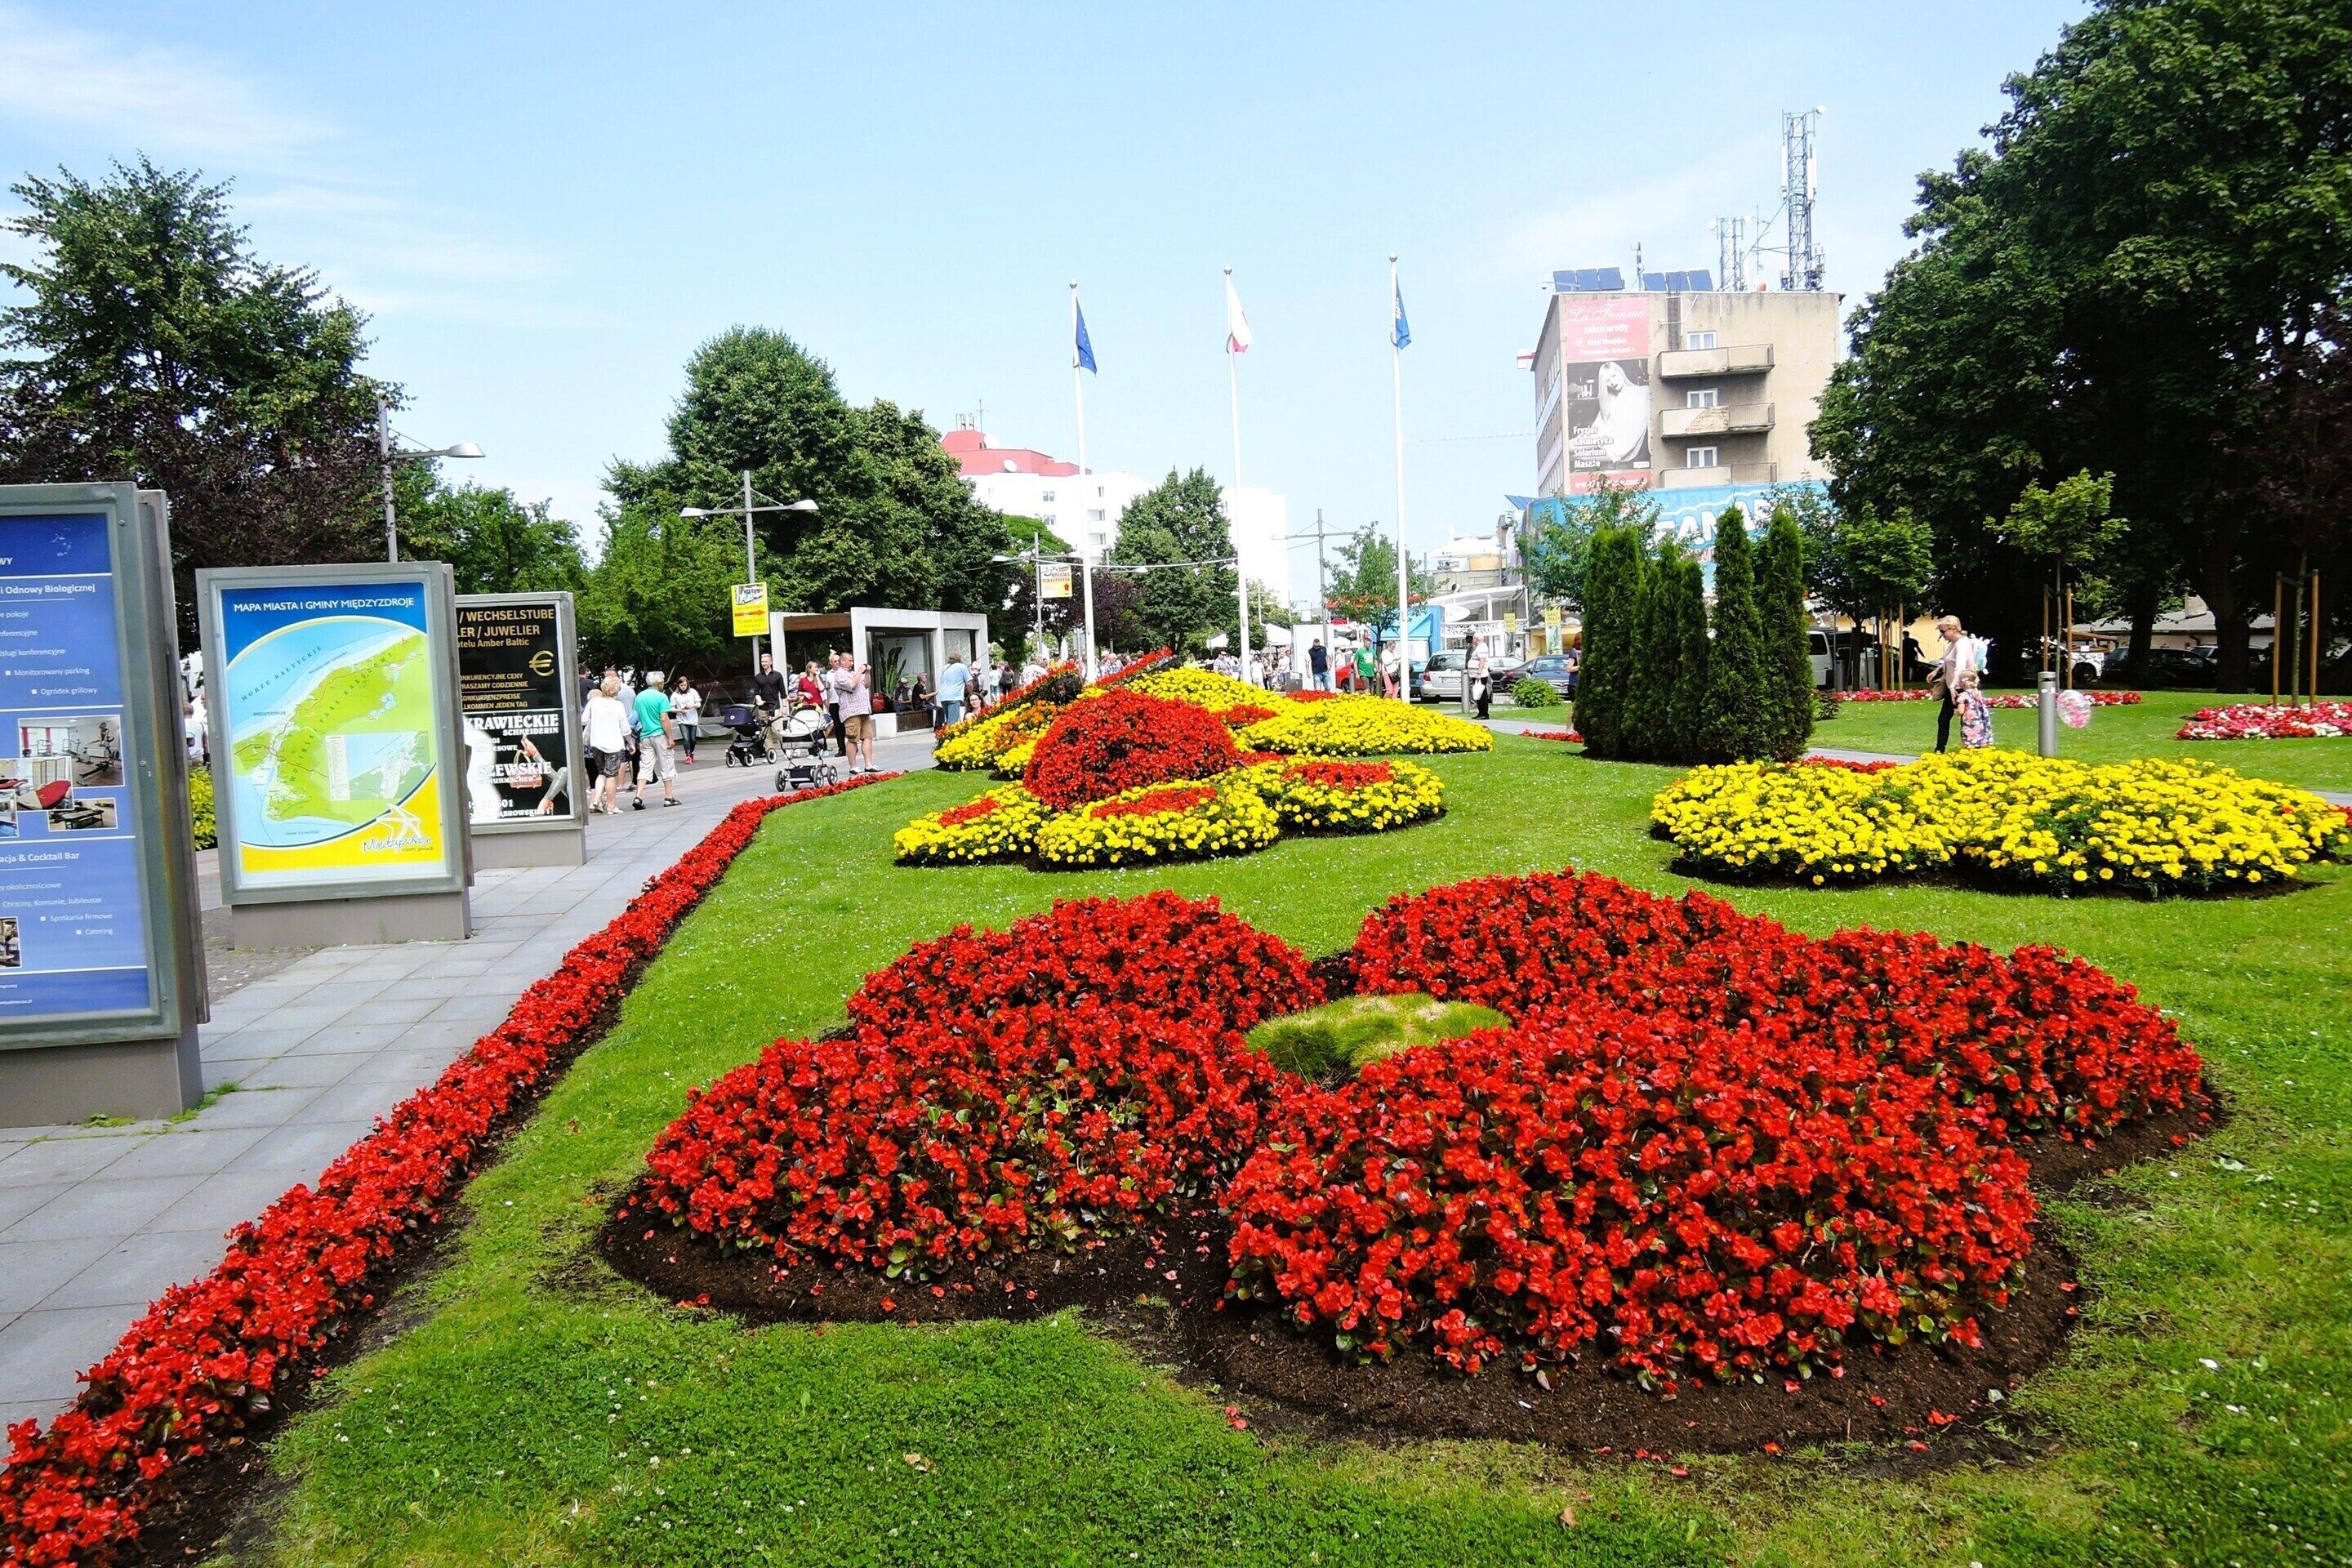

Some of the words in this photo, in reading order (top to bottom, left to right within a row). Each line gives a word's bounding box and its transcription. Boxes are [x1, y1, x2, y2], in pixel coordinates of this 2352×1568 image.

[1585, 325, 1605, 333] salon
[1606, 323, 1628, 333] urody
[1573, 425, 1598, 435] Fryzjer
[1574, 436, 1614, 446] Kosmetyka
[1574, 448, 1606, 457] Solarium
[1574, 459, 1601, 468] Masaże
[6, 586, 42, 595] Odnowy
[45, 583, 95, 593] Biologicznej
[234, 604, 261, 612] MAPA
[263, 602, 299, 610] MIASTA
[300, 601, 303, 609] I
[305, 600, 339, 609] GMINY
[341, 597, 414, 609] MIĘDZYZDROJE
[466, 608, 555, 621] WECHSELSTUBE
[457, 627, 475, 637] ER
[483, 625, 541, 636] JUWELIER
[477, 639, 505, 648] Amber
[506, 637, 529, 646] Baltic
[65, 667, 90, 675] parking
[41, 688, 69, 696] Ogródek
[241, 680, 270, 702] MORZE
[463, 714, 559, 730] KRAWIECKIE
[502, 727, 559, 737] SCHNEIDERIN
[478, 761, 552, 777] SZEWSKIE
[19, 853, 26, 862] &
[28, 853, 63, 862] Cocktail
